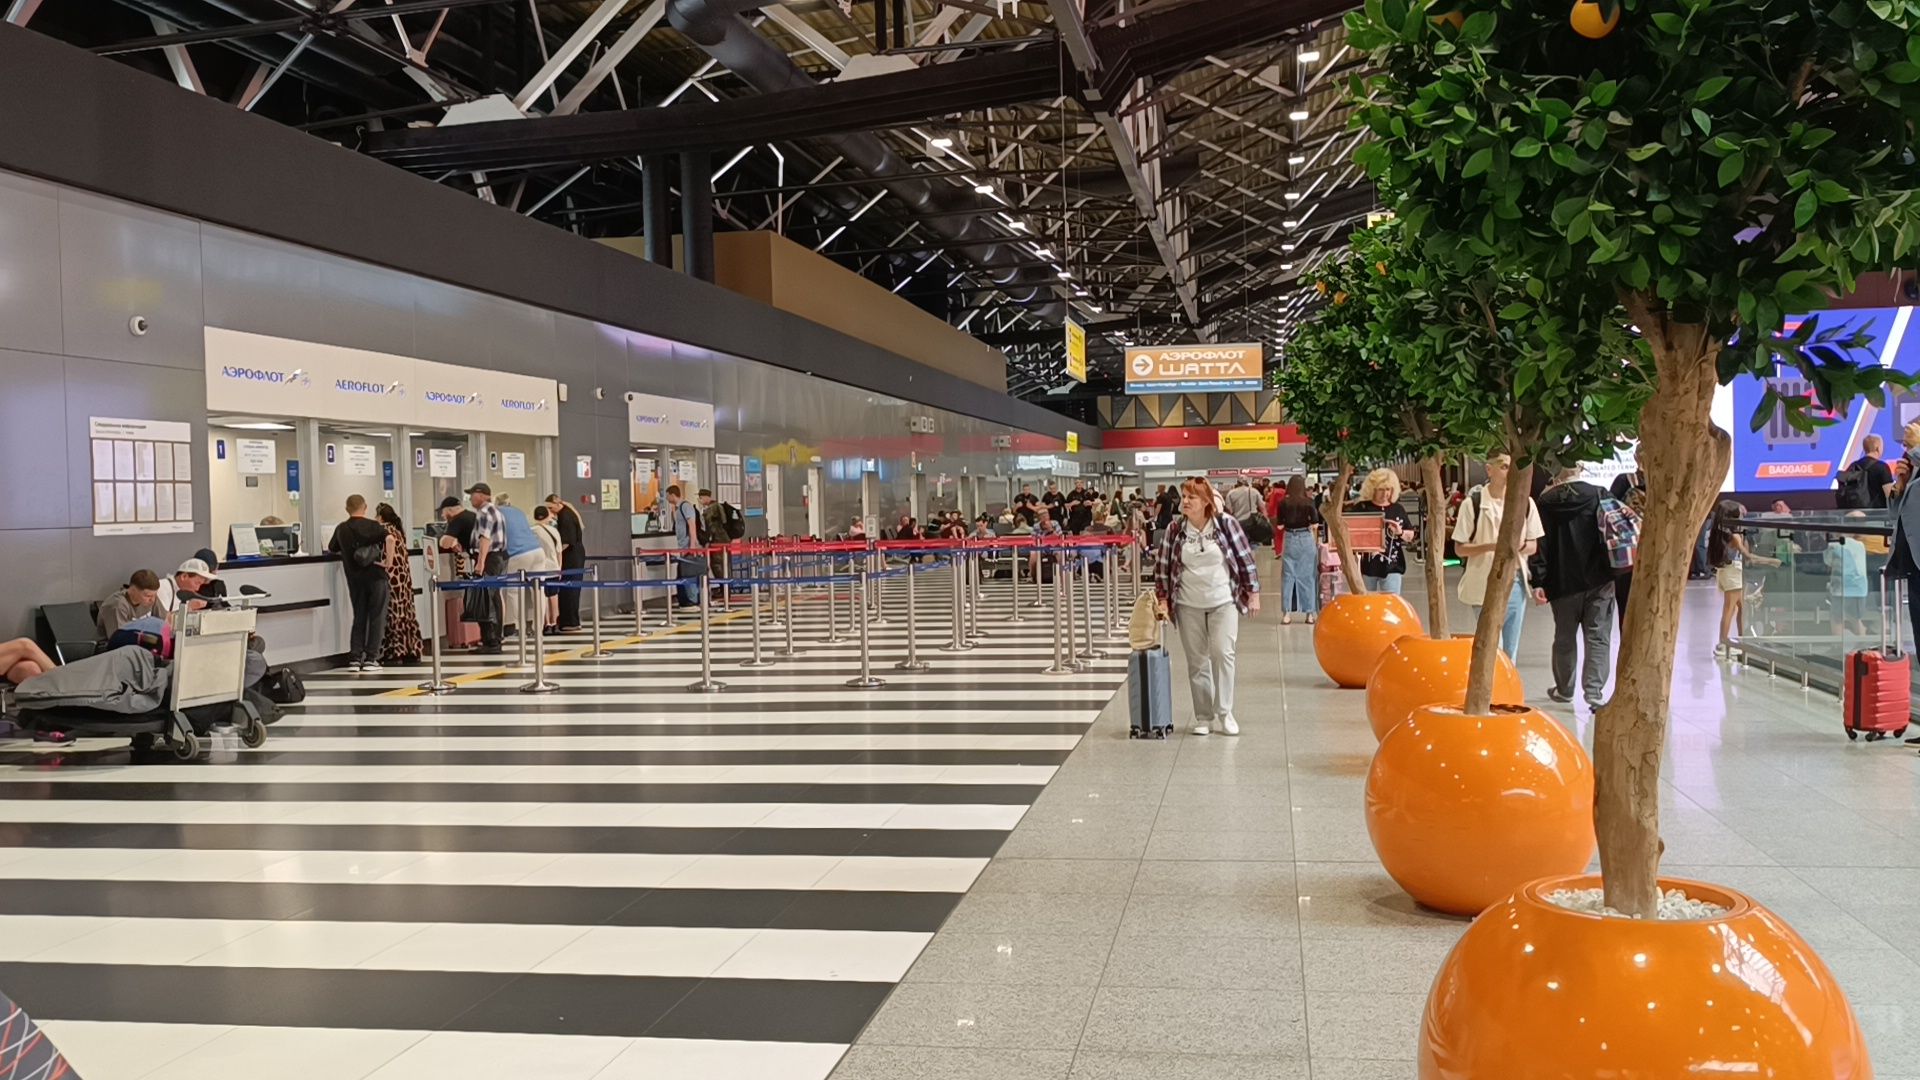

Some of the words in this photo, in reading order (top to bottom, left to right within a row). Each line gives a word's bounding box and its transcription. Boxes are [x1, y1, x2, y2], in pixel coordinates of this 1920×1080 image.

[1160, 350, 1246, 361] АЭРОФЛОТ
[222, 366, 284, 382] АЭРОФЛОТ
[1159, 362, 1245, 375] ШАТТЛ
[335, 379, 385, 394] AEROFLOT
[425, 391, 465, 404] АЭРОФЛОТ
[501, 399, 535, 410] AEROFLOT
[1769, 465, 1813, 474] BAGGAGE
